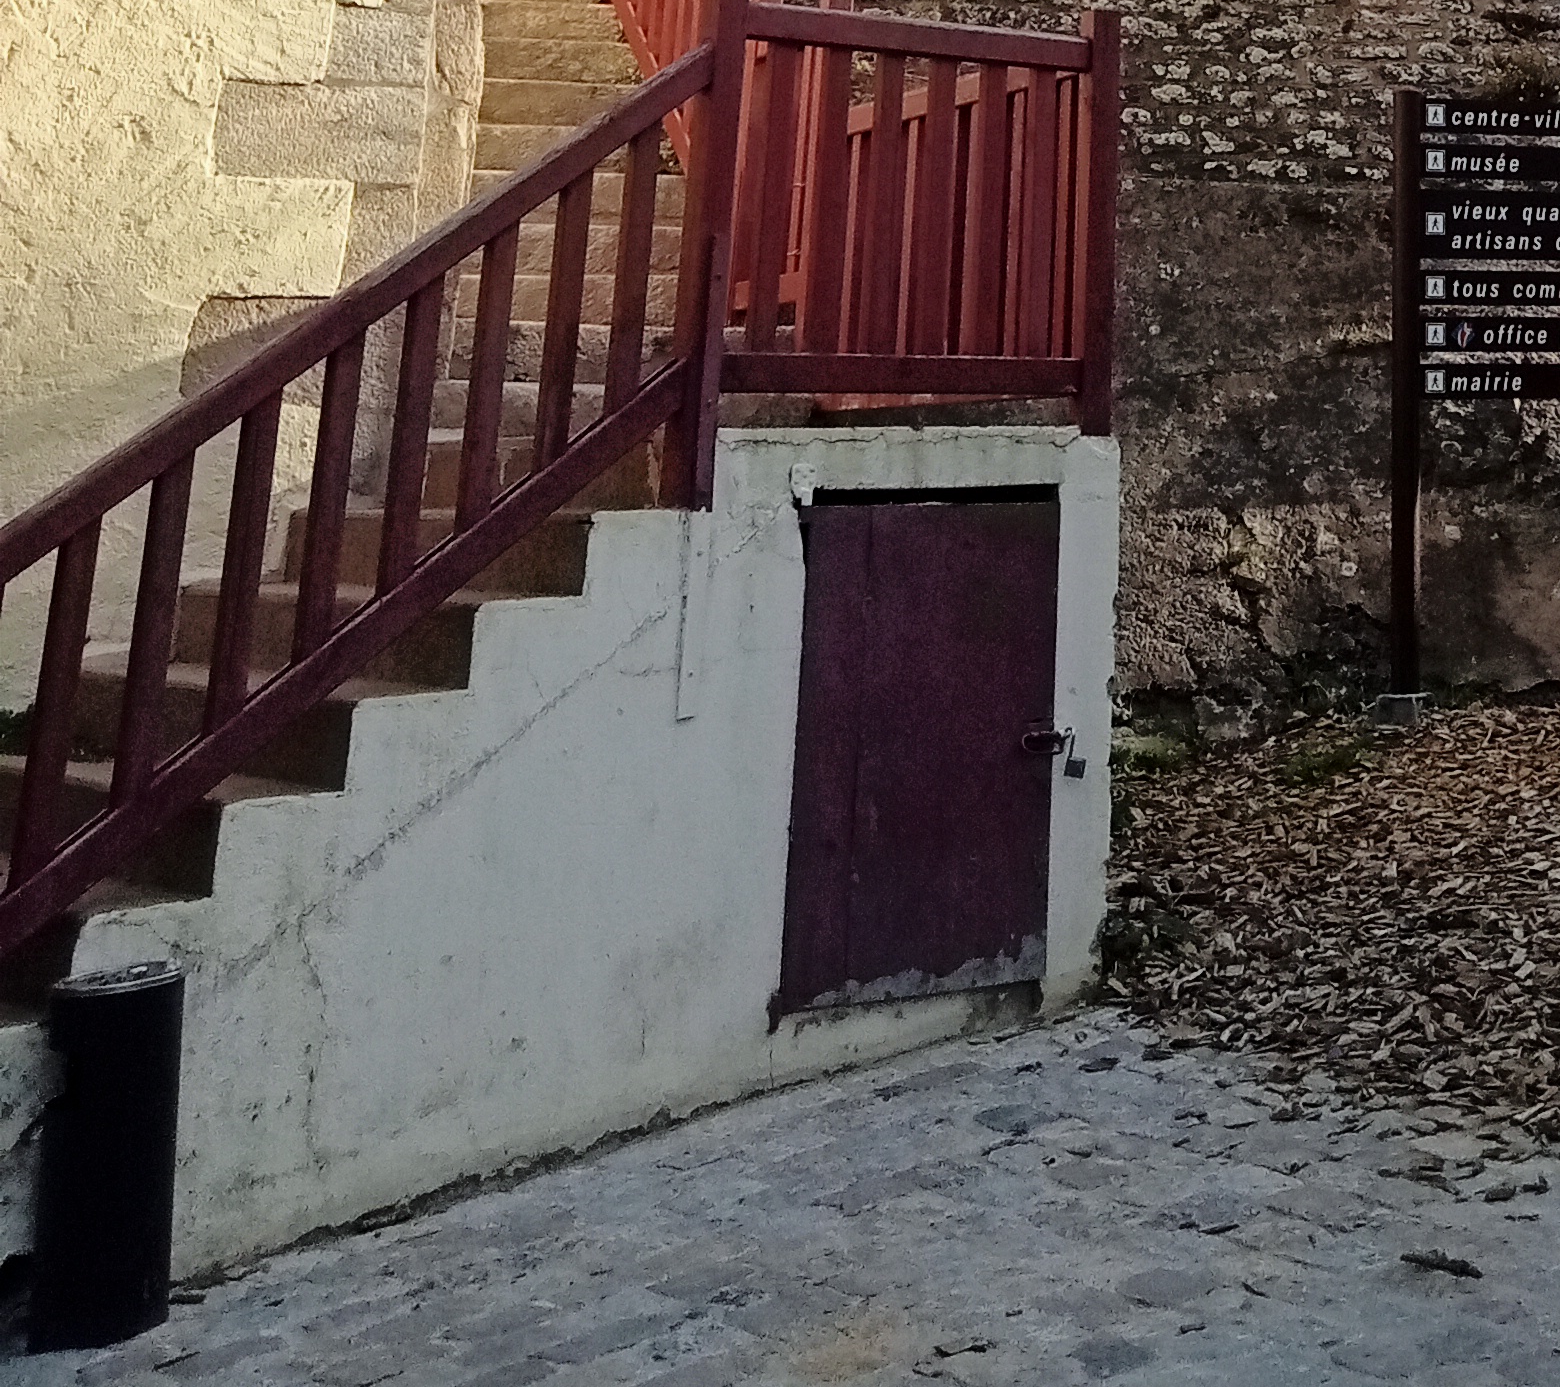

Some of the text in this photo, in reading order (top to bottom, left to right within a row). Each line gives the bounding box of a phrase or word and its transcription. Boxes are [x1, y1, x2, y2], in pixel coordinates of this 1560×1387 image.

[1450, 152, 1520, 173] musée
[1452, 200, 1509, 221] vieux
[1451, 229, 1542, 251] artisans
[1452, 279, 1500, 298] tous
[1483, 324, 1548, 345] office
[1451, 371, 1522, 392] mairie
